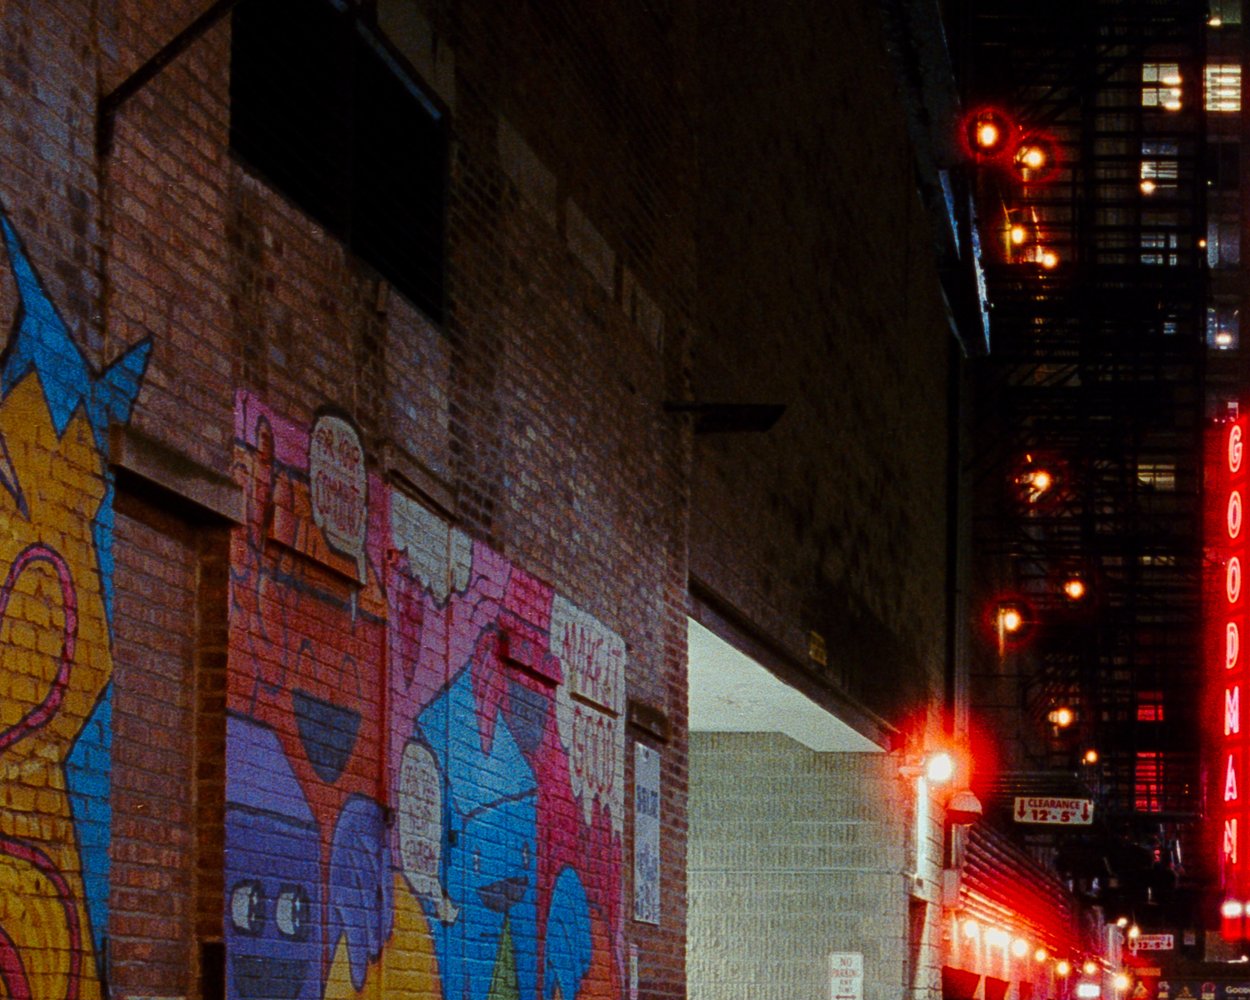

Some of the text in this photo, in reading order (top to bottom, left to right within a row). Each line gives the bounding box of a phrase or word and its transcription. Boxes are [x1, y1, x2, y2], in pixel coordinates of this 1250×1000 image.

[1223, 425, 1242, 864] GOODMAN
[1028, 799, 1080, 809] CLEARANCE
[840, 957, 852, 967] NO
